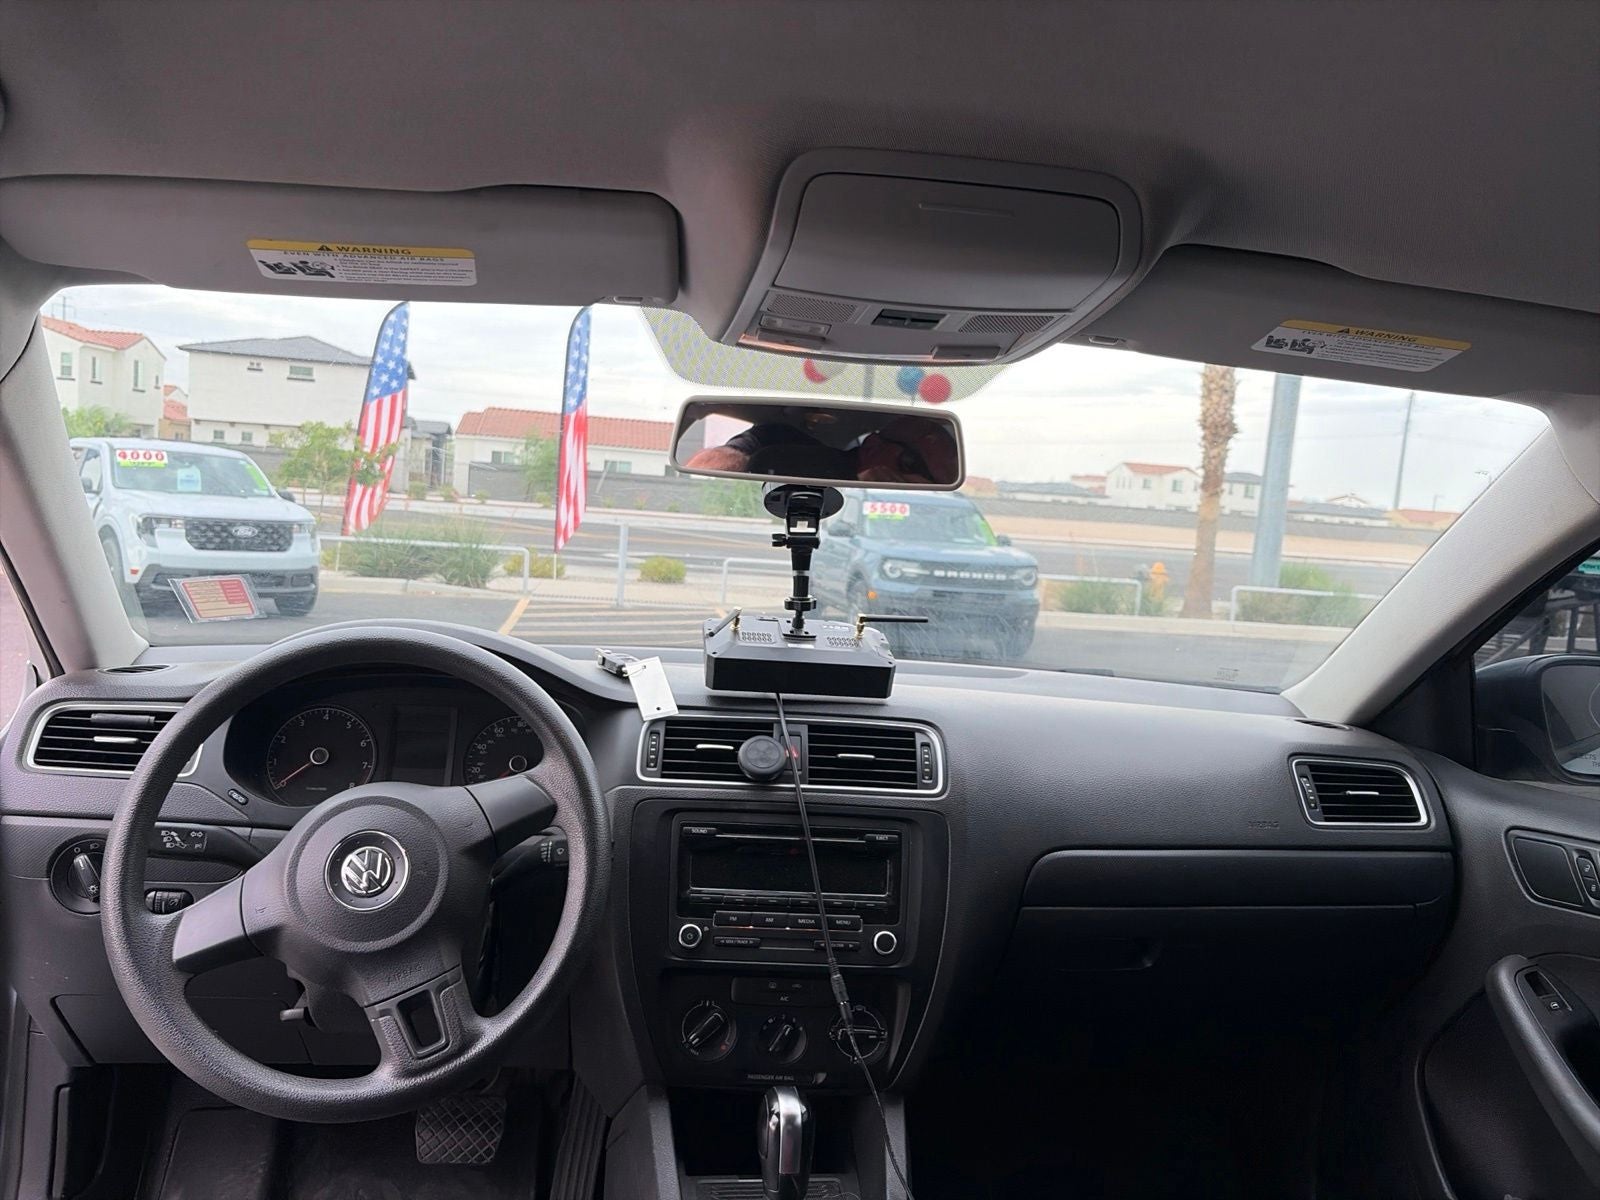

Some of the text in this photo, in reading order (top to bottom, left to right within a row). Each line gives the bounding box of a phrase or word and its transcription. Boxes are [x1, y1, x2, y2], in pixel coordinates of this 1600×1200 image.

[337, 246, 411, 255] WARNING
[1355, 329, 1418, 342] WARNING
[118, 450, 165, 462] 4000
[870, 503, 908, 514] 5500
